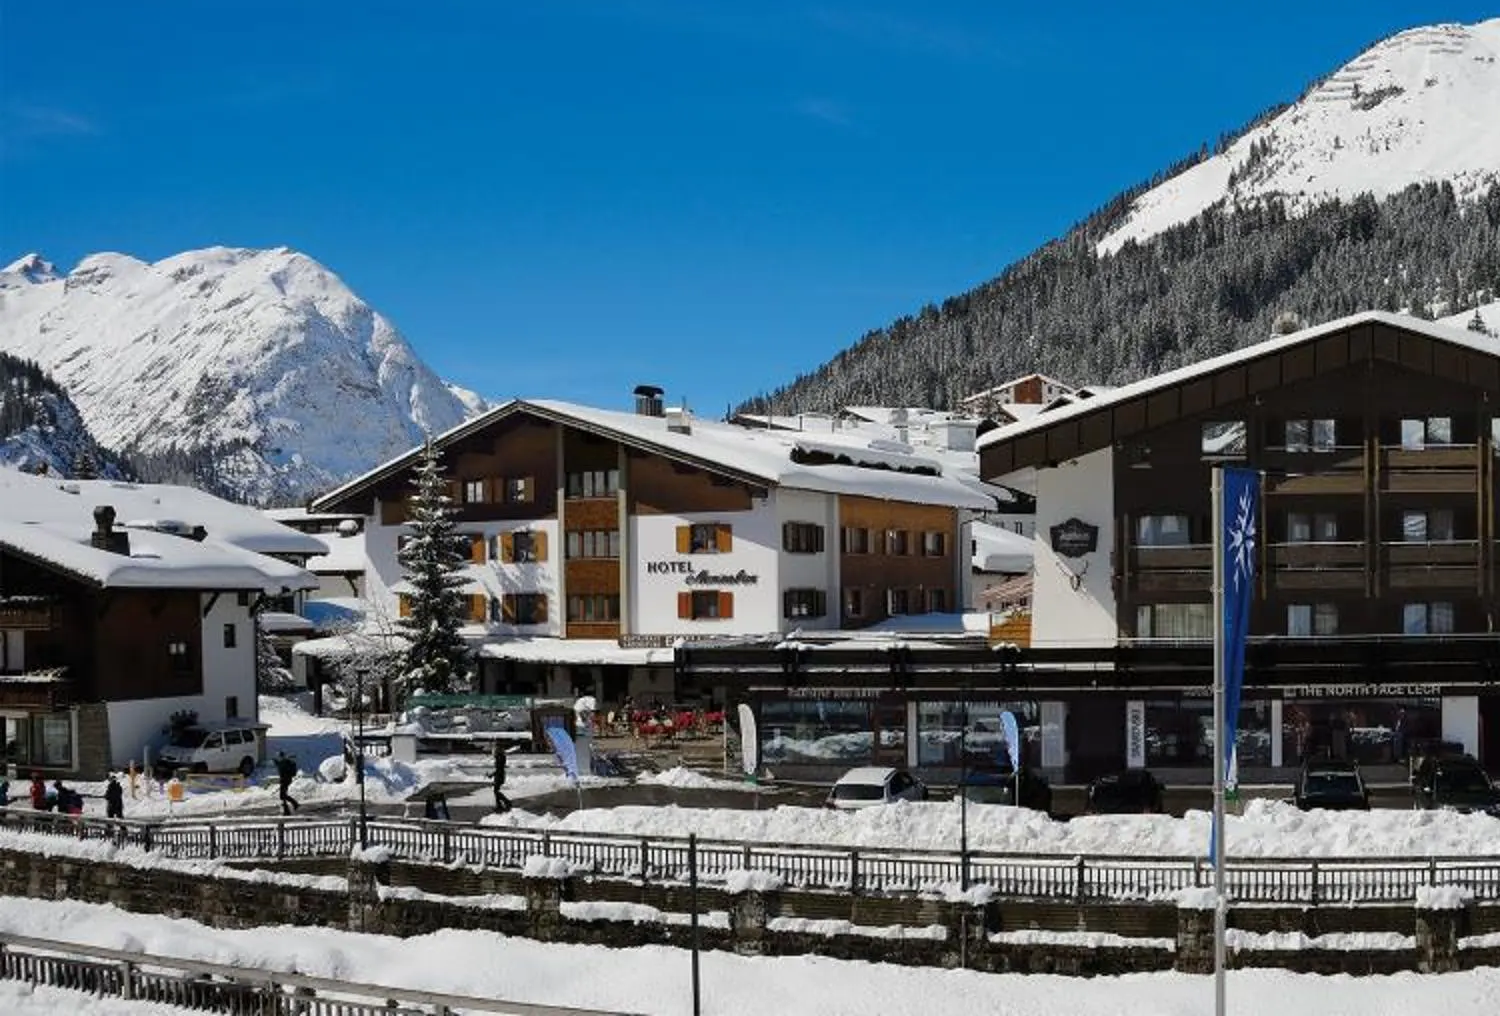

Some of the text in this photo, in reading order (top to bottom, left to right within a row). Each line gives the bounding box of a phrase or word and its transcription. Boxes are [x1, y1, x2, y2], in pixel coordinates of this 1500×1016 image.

[647, 561, 694, 574] HOTEL
[1301, 683, 1441, 697] THE NORTH FACE LECH
